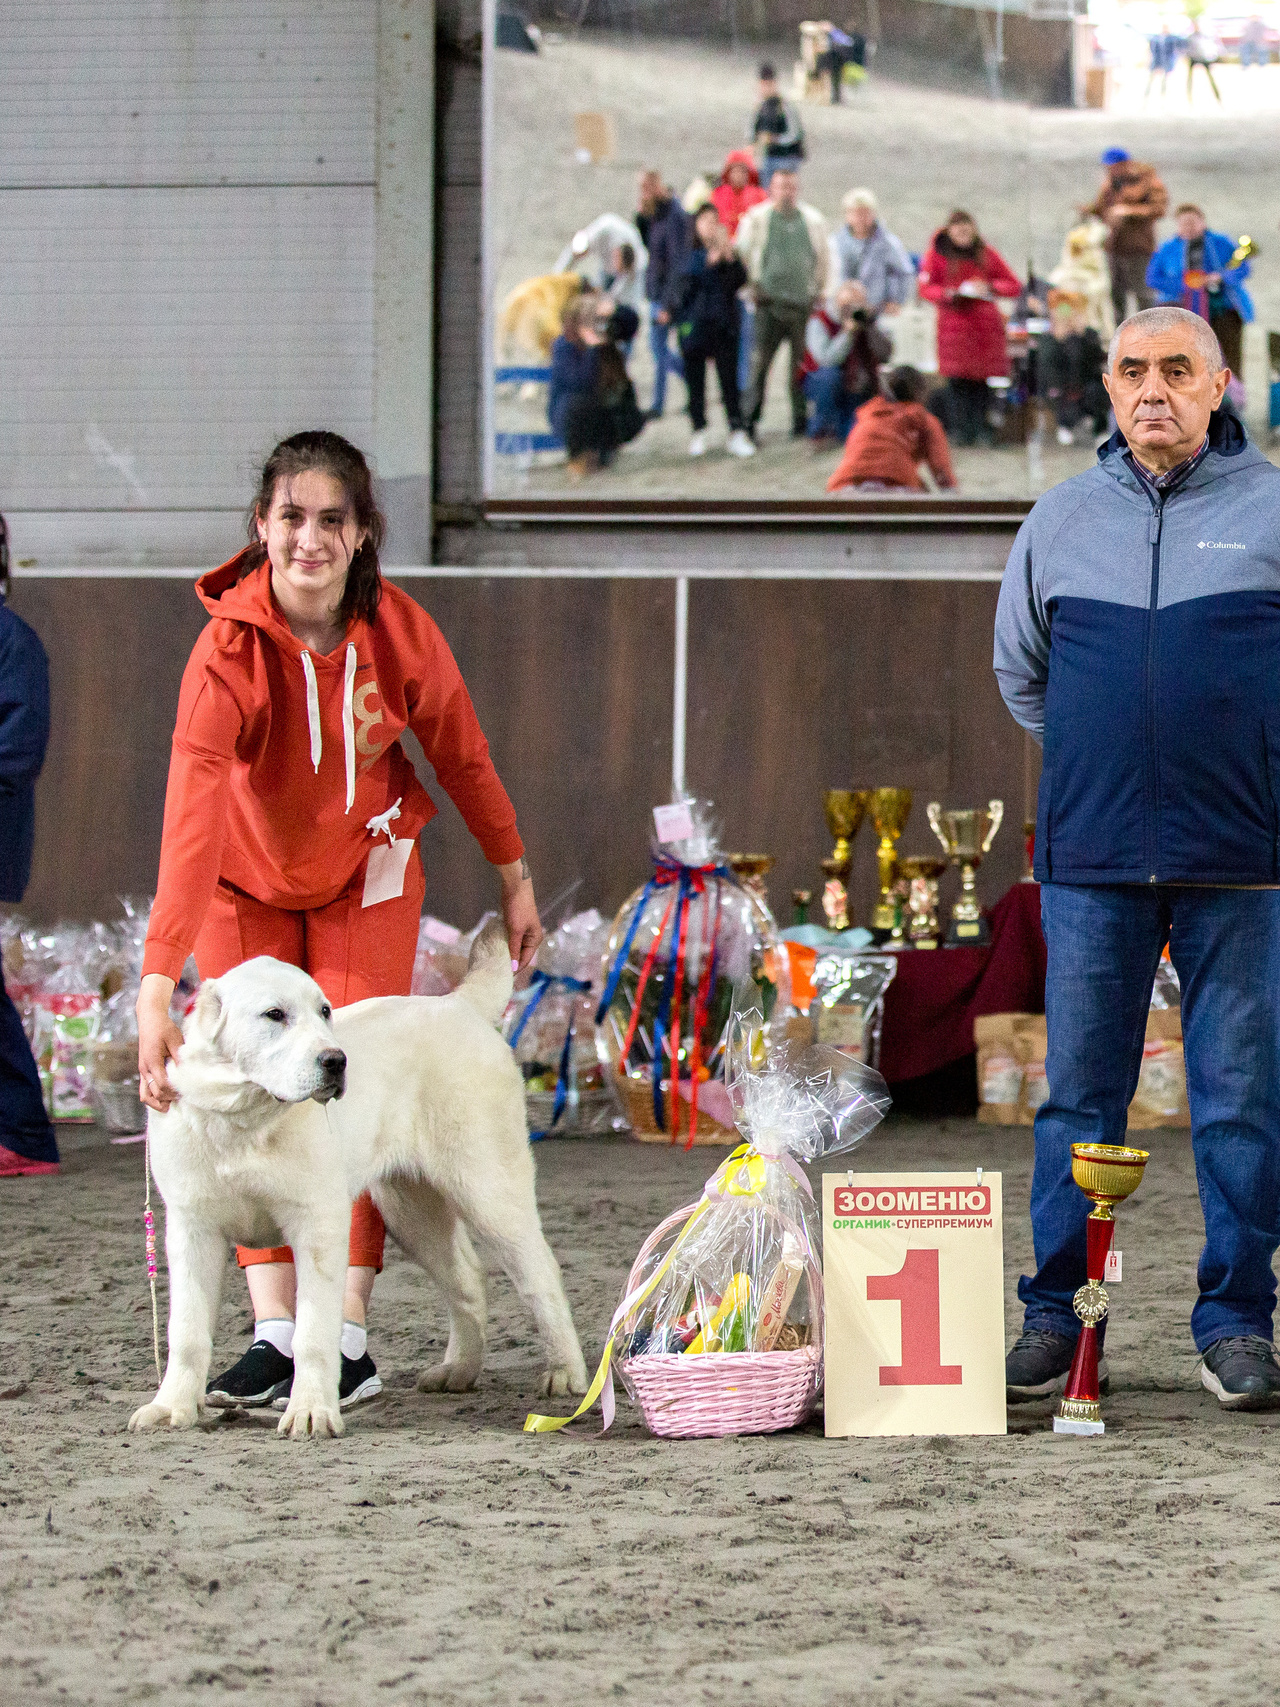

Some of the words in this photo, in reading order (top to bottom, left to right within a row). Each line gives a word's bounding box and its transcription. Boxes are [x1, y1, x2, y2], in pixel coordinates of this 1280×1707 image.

[1206, 540, 1246, 550] Columbia
[838, 1191, 986, 1212] ЗООМЕНЮ
[866, 1249, 962, 1386] 1
